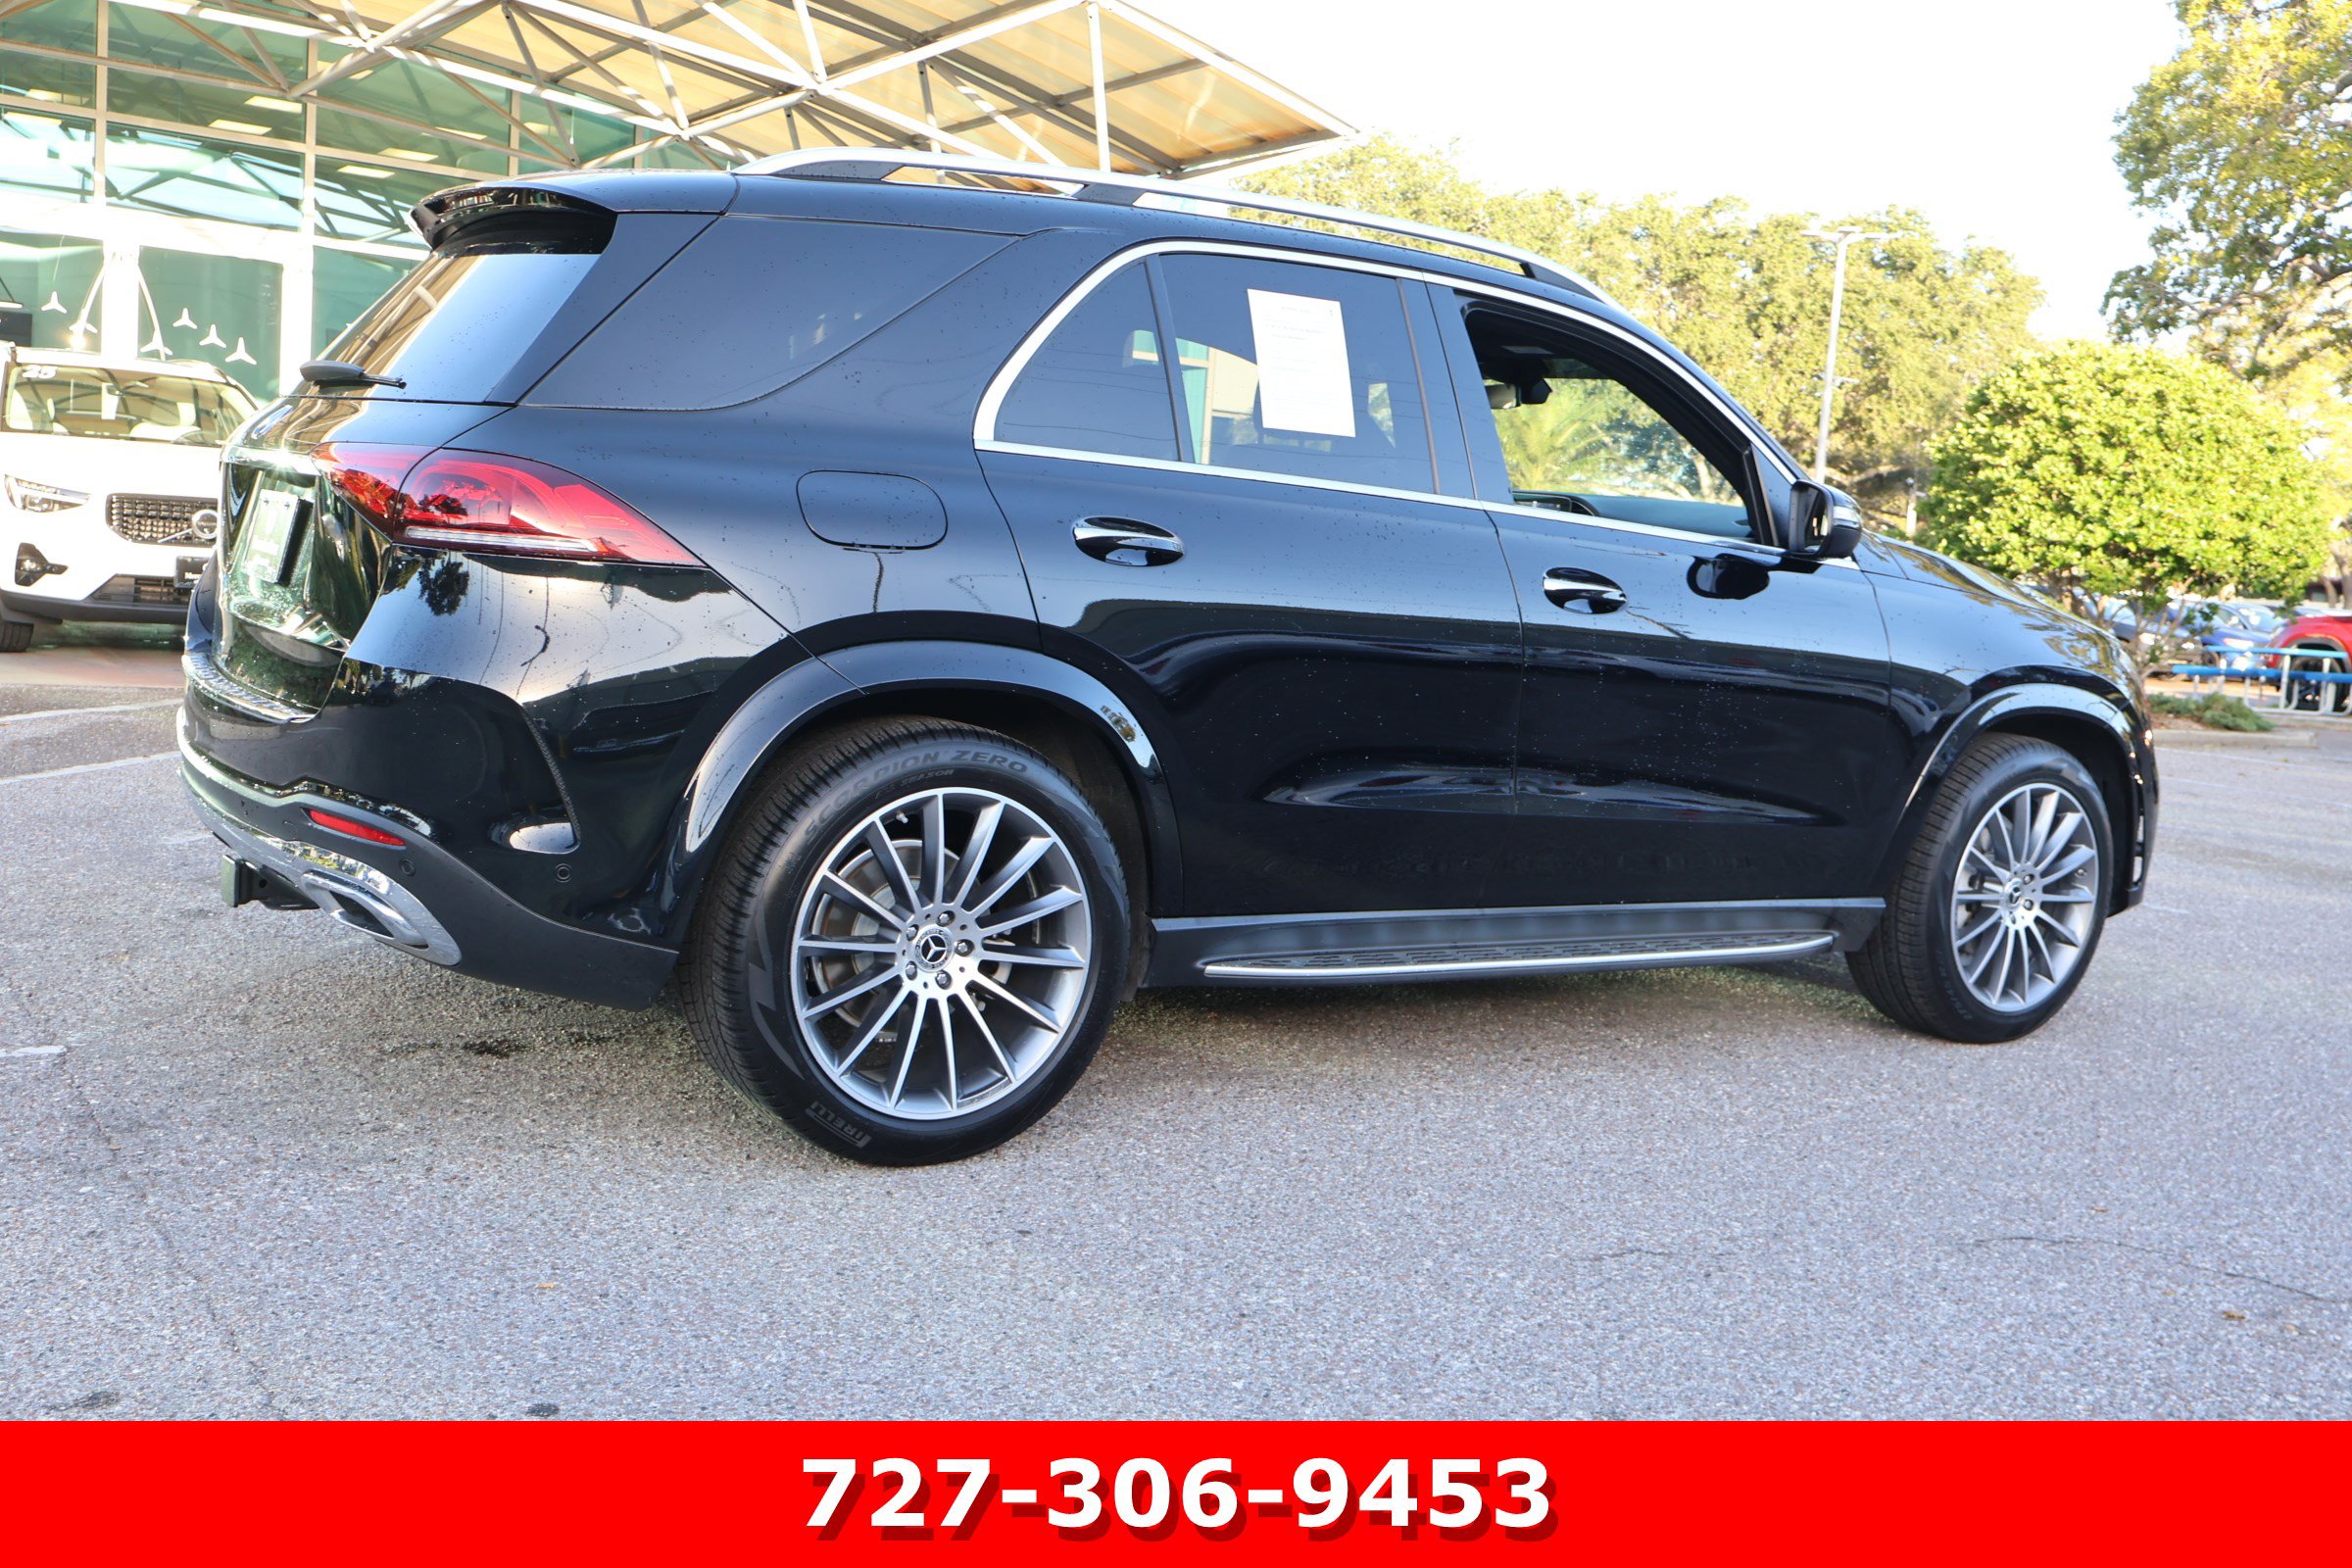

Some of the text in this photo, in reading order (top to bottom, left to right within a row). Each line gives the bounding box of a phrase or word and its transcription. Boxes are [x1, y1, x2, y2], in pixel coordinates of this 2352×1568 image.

[805, 750, 1028, 837] SCORPION ZERO
[805, 1101, 872, 1148] PIRELLI
